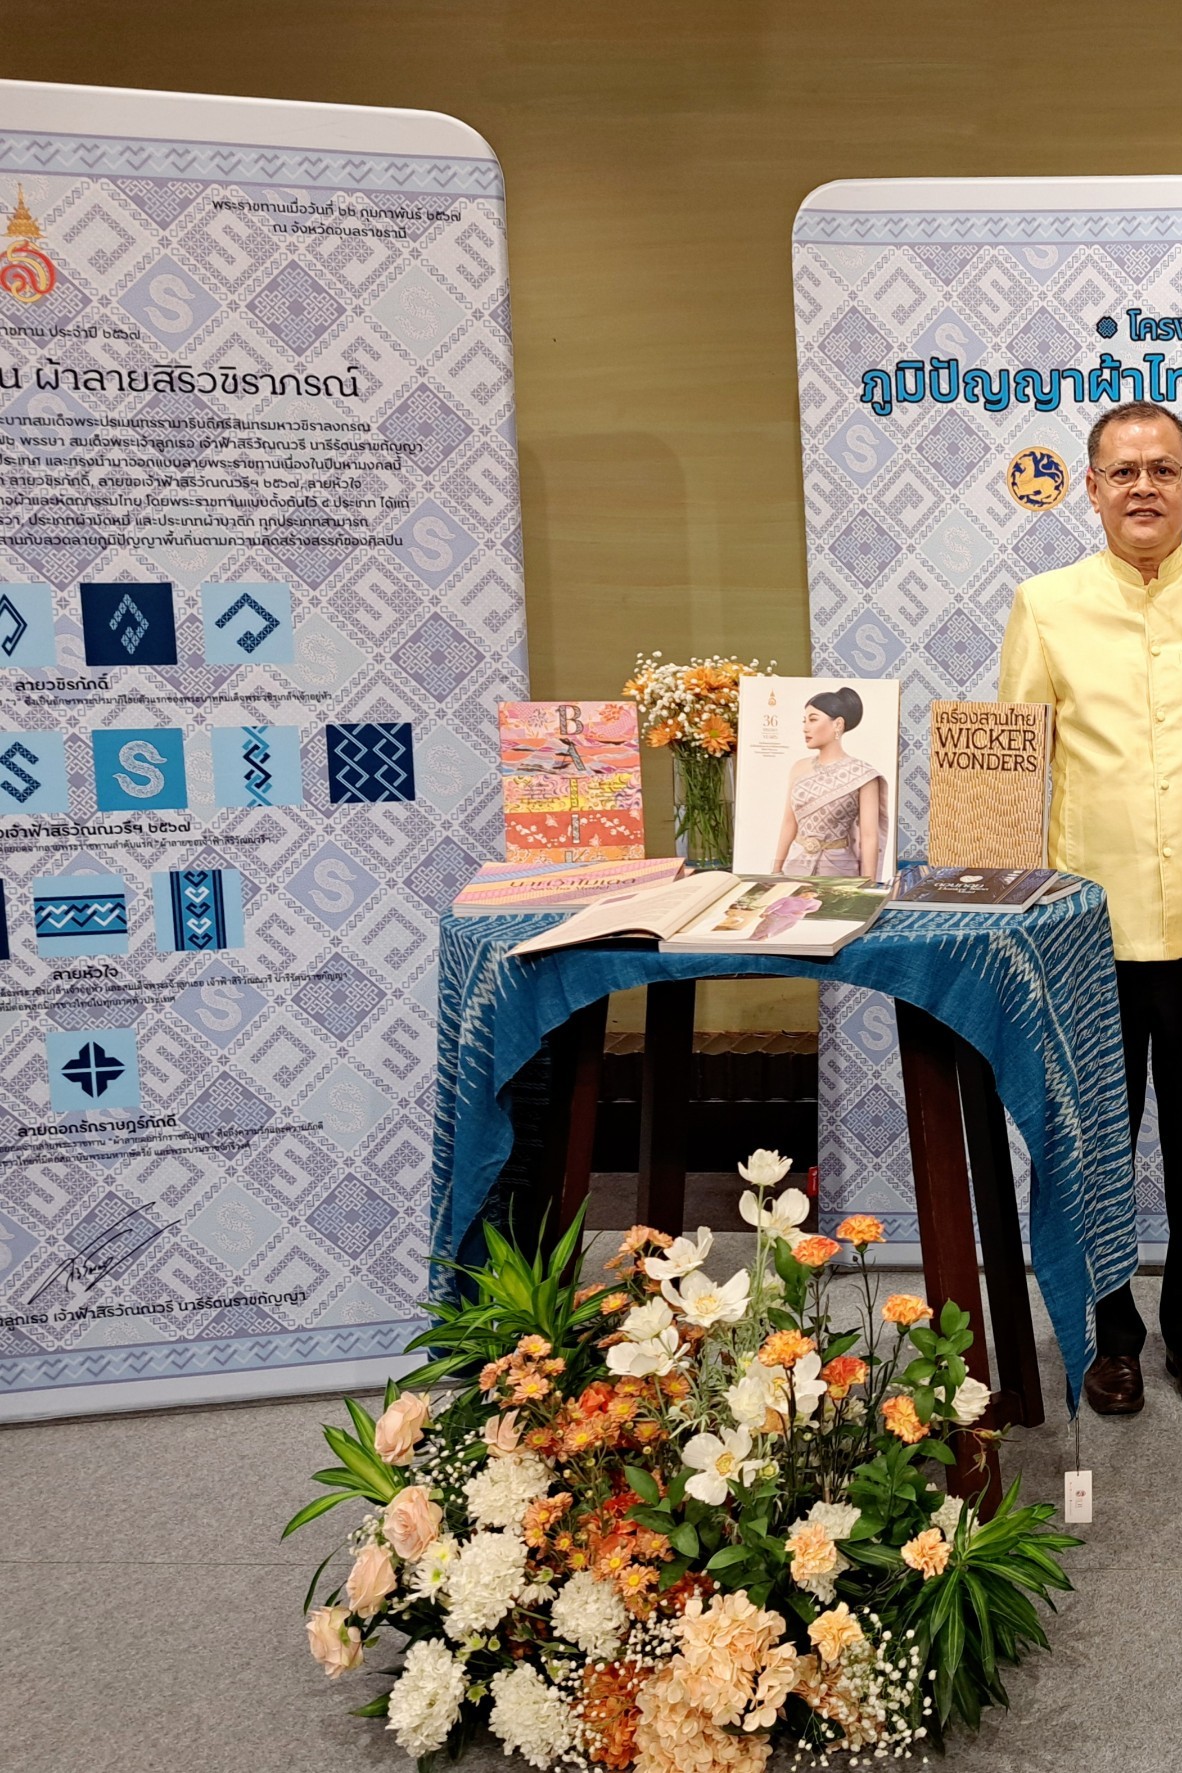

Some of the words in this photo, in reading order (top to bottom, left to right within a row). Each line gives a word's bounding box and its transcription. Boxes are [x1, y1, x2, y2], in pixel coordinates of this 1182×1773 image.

[273, 222, 287, 232] ณ
[35, 358, 360, 398] ผ้าลายสิริวชิราภรณ์
[15, 672, 109, 692] ลายวชิรภักดิ์
[762, 714, 778, 727] 36
[936, 726, 1036, 751] WICKER
[934, 751, 1037, 772] WONDERS
[149, 821, 191, 834] ๒๕๖๗
[53, 964, 118, 981] ลายหัวใจ
[18, 1114, 178, 1138] ลายดอกรักราษฎร์ภักดี
[54, 1300, 174, 1322] เจ้าฟ้าสิริวัณณวรี
[179, 1291, 306, 1311] นารีรัตนราชกัญญา
